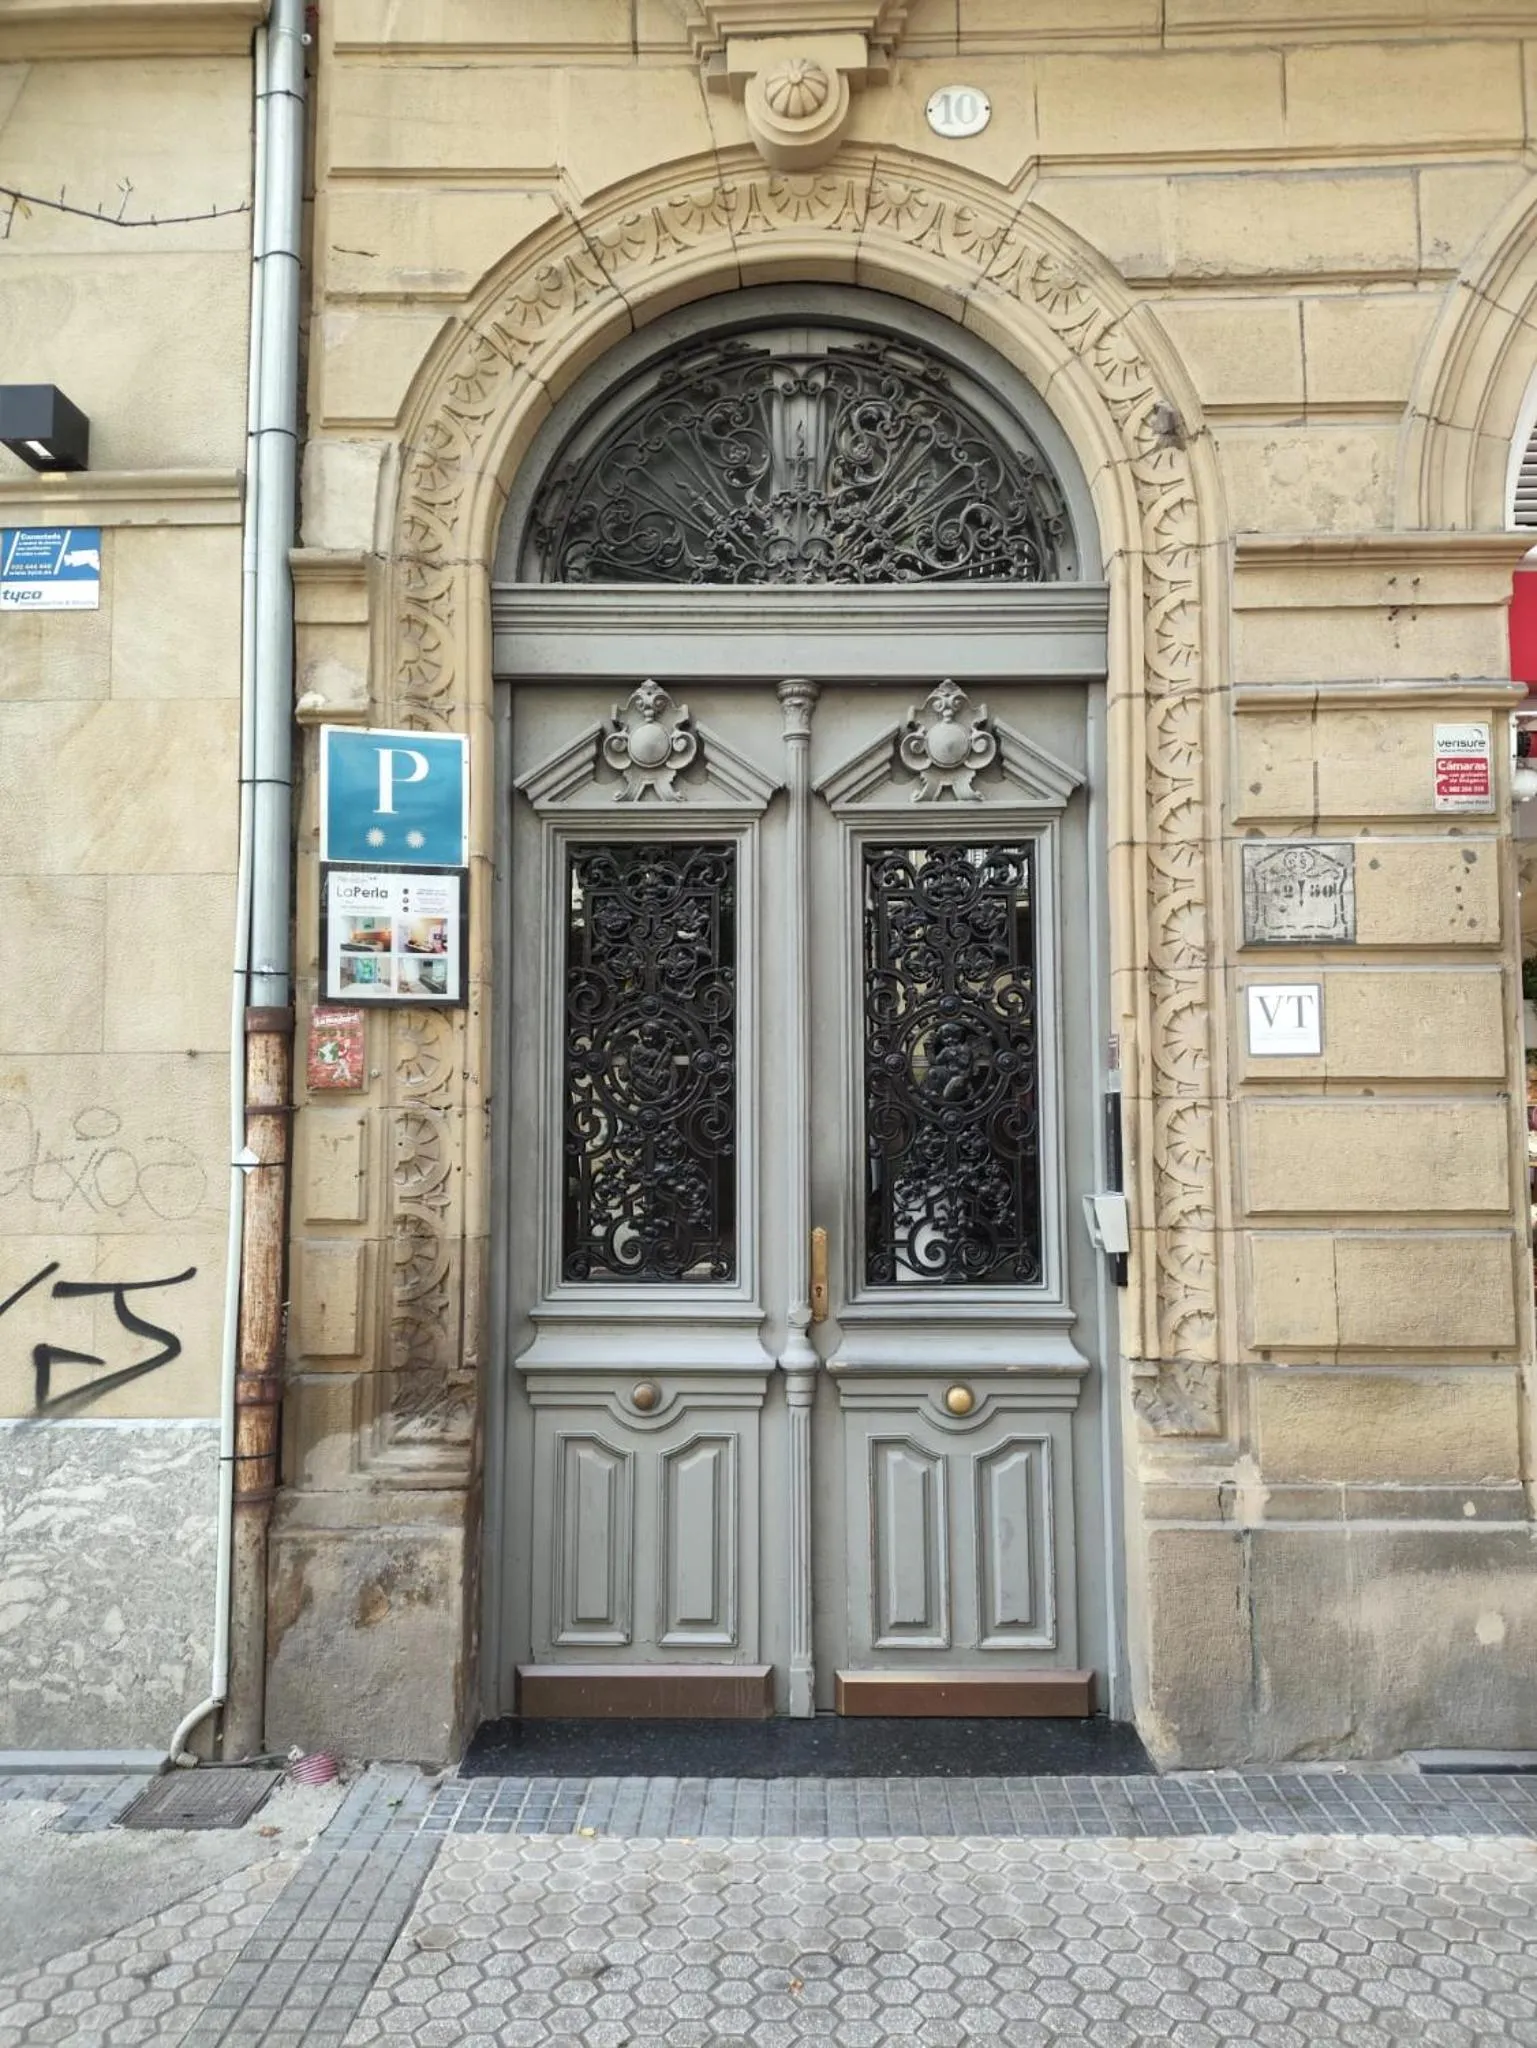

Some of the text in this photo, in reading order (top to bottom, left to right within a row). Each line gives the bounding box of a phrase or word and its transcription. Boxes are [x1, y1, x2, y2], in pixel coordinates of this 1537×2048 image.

[935, 94, 979, 125] 10
[2, 589, 43, 603] tyco
[1437, 739, 1486, 748] verisure
[1438, 760, 1487, 771] Cámaras
[372, 747, 430, 815] P
[1253, 994, 1314, 1029] VT
